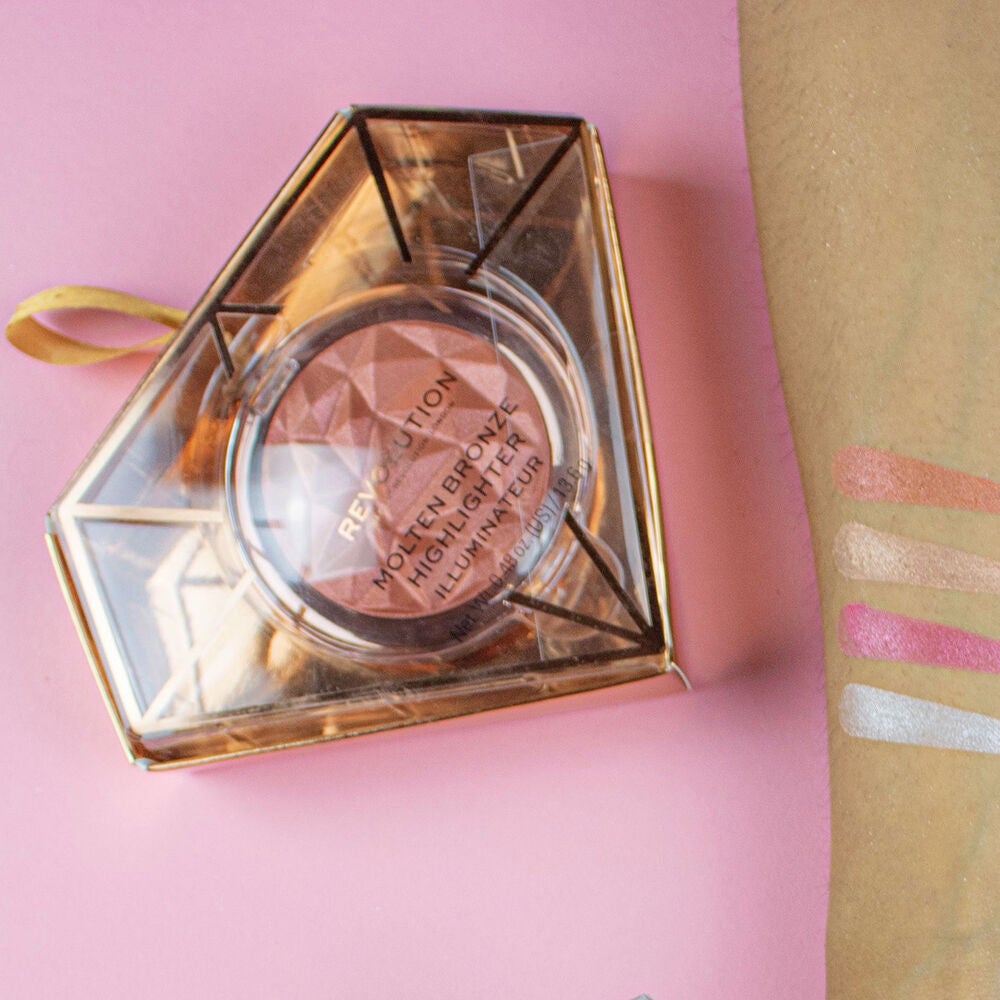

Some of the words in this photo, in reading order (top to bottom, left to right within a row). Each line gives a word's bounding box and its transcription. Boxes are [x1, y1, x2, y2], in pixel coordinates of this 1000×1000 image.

[373, 495, 445, 590] MOLTEN
[442, 397, 518, 494] BRONZE
[408, 432, 526, 588] HIGHLIGHTER
[435, 456, 543, 600] ILLUMINATEUR
